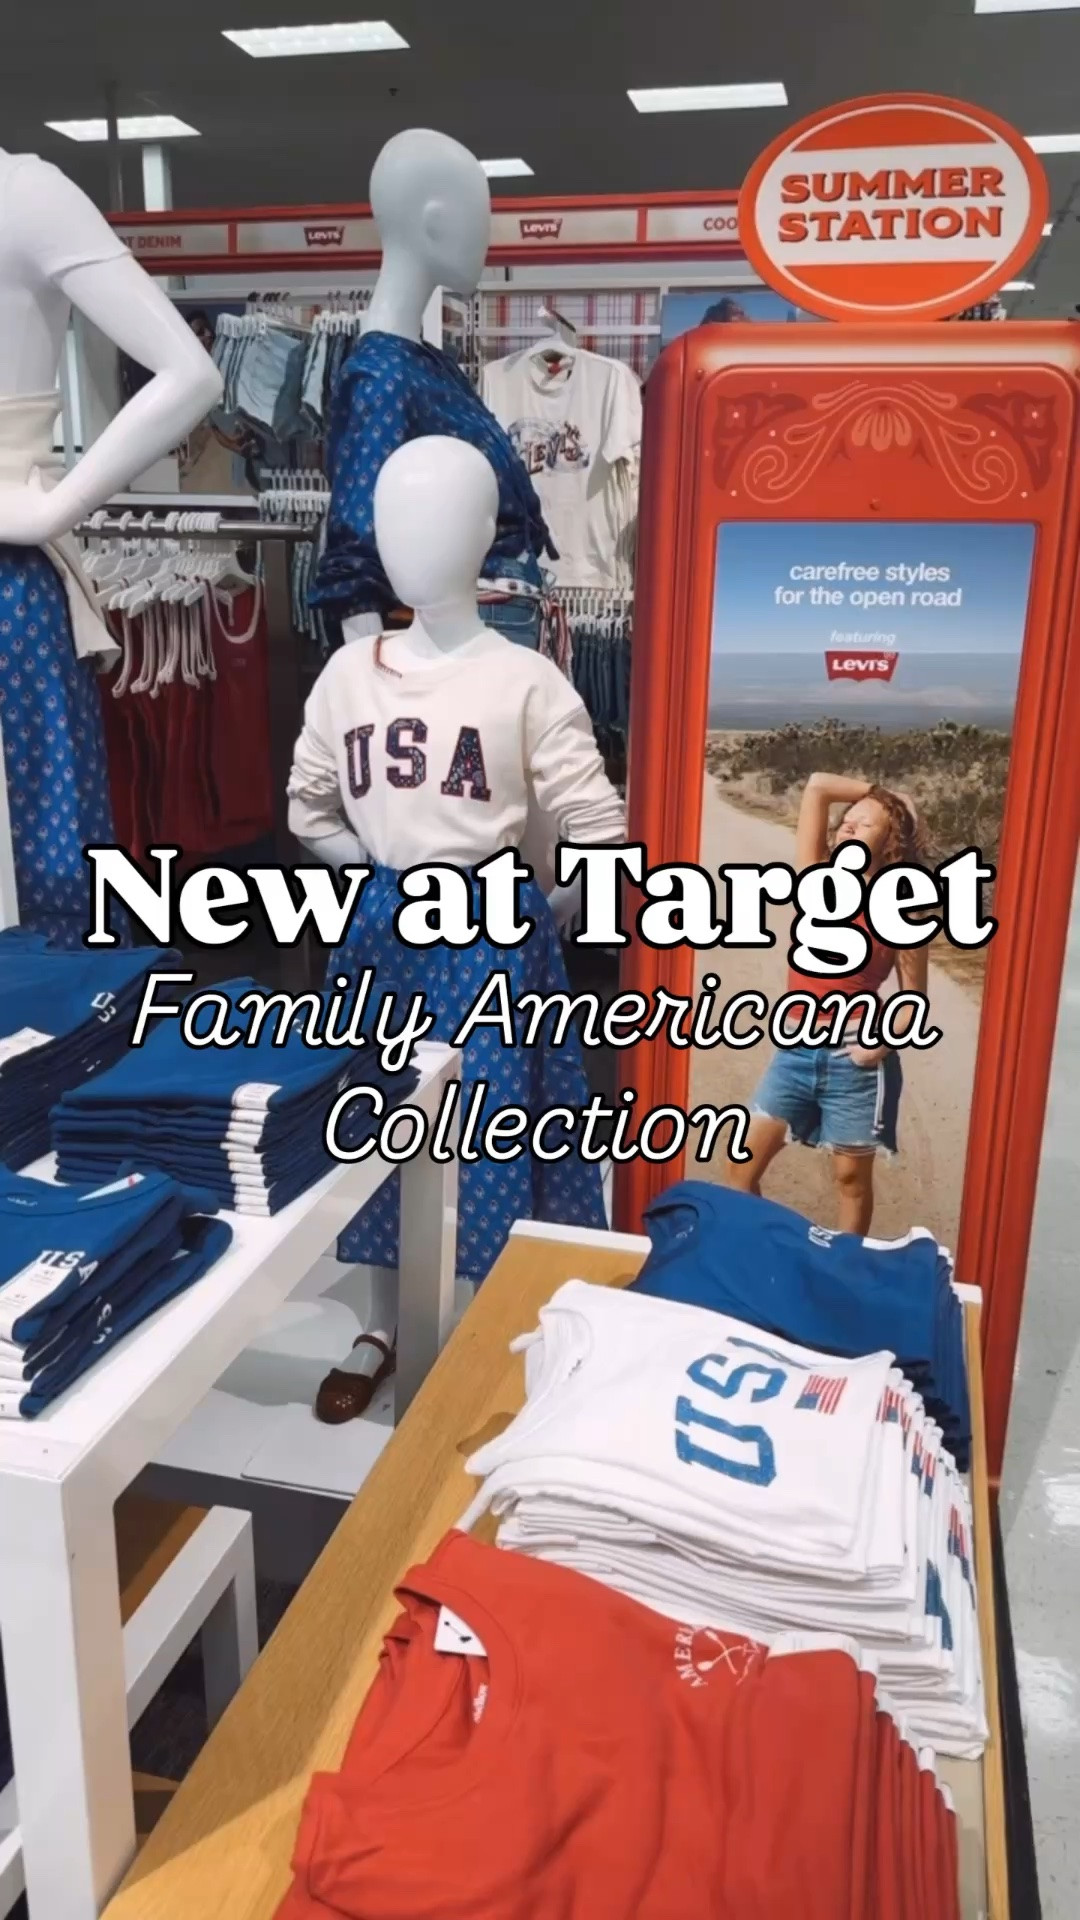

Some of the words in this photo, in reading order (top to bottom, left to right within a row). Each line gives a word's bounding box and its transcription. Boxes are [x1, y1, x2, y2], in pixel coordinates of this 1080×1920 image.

[779, 166, 1006, 203] SUMMER
[777, 206, 1004, 243] STATION
[137, 235, 182, 249] DENIM
[789, 562, 880, 582] carefree
[885, 562, 951, 586] styles
[774, 586, 804, 605] for
[809, 586, 845, 606] the
[849, 590, 905, 609] open
[911, 588, 963, 607] road
[830, 630, 897, 646] featuring
[344, 717, 492, 802] USA
